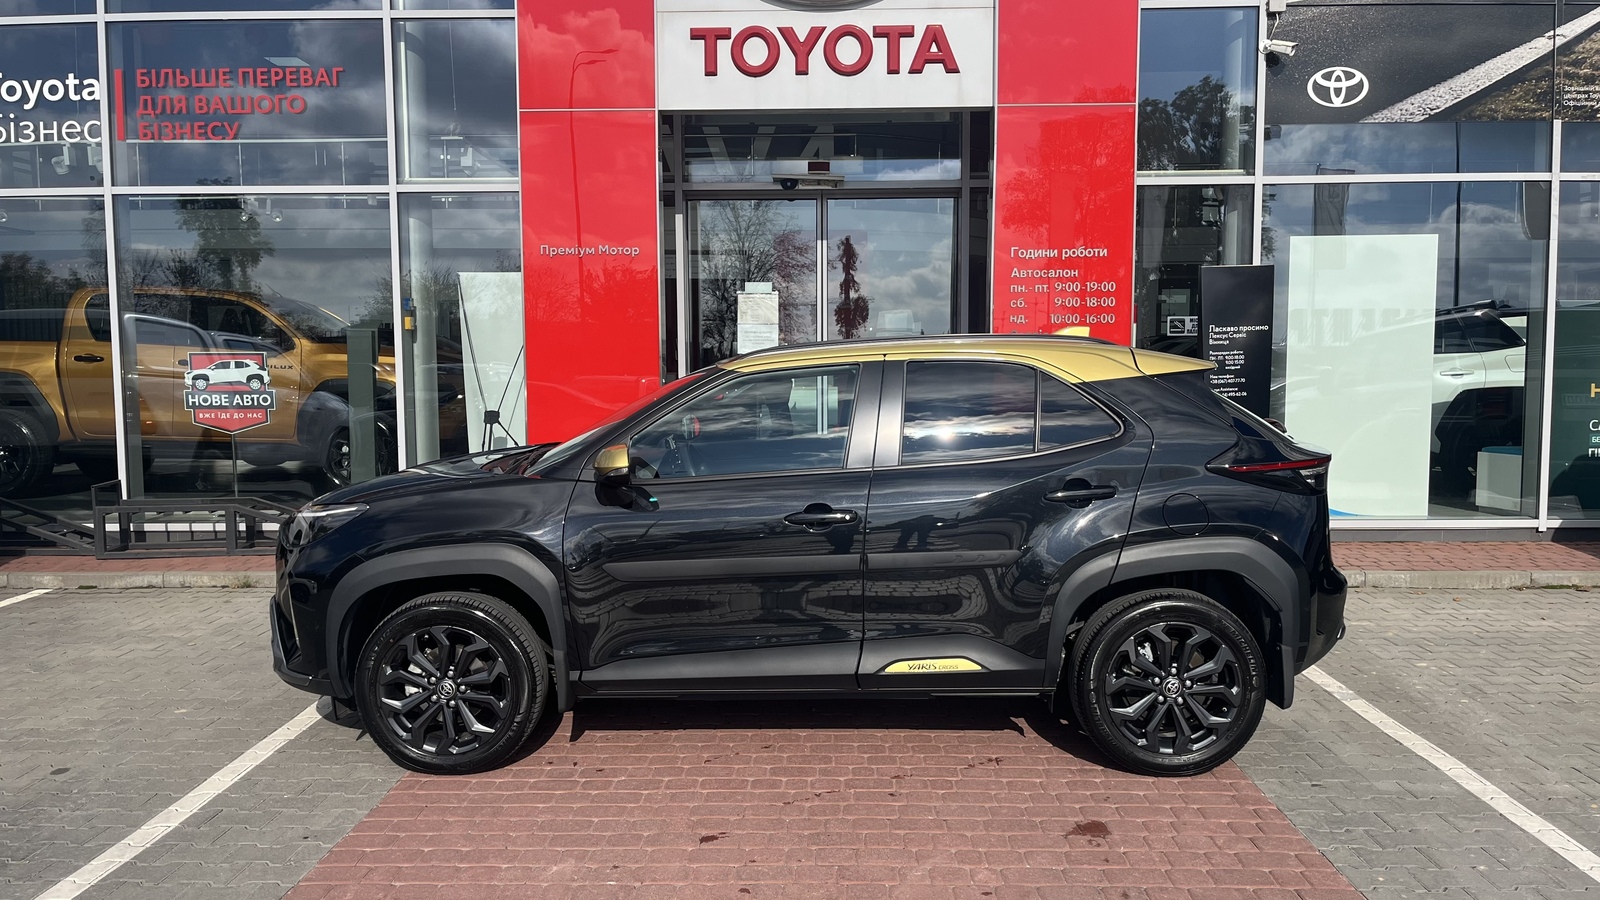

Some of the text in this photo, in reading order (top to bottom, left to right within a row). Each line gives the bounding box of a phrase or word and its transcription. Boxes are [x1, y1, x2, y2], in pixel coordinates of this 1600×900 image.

[690, 24, 961, 78] TOYOTA
[136, 67, 344, 88] БІЛЬШЕ ПЕРЕВАГ
[136, 94, 306, 118] ДЛЯ ВАШОГО
[137, 121, 240, 141] БІЗНЕСУ
[540, 244, 640, 258] Преміум Мотор
[1010, 246, 1108, 260] Години роботи
[1010, 268, 1079, 278] Автосалон
[1054, 281, 1116, 292] 9:00-19:00
[1010, 297, 1116, 308] сб. 9:00-18:00
[1009, 313, 1116, 324] нд. 10:00-16:00
[188, 394, 271, 406] НОВЕ АВТО
[218, 411, 231, 419] ЇДЕ
[907, 662, 937, 671] YARIS
